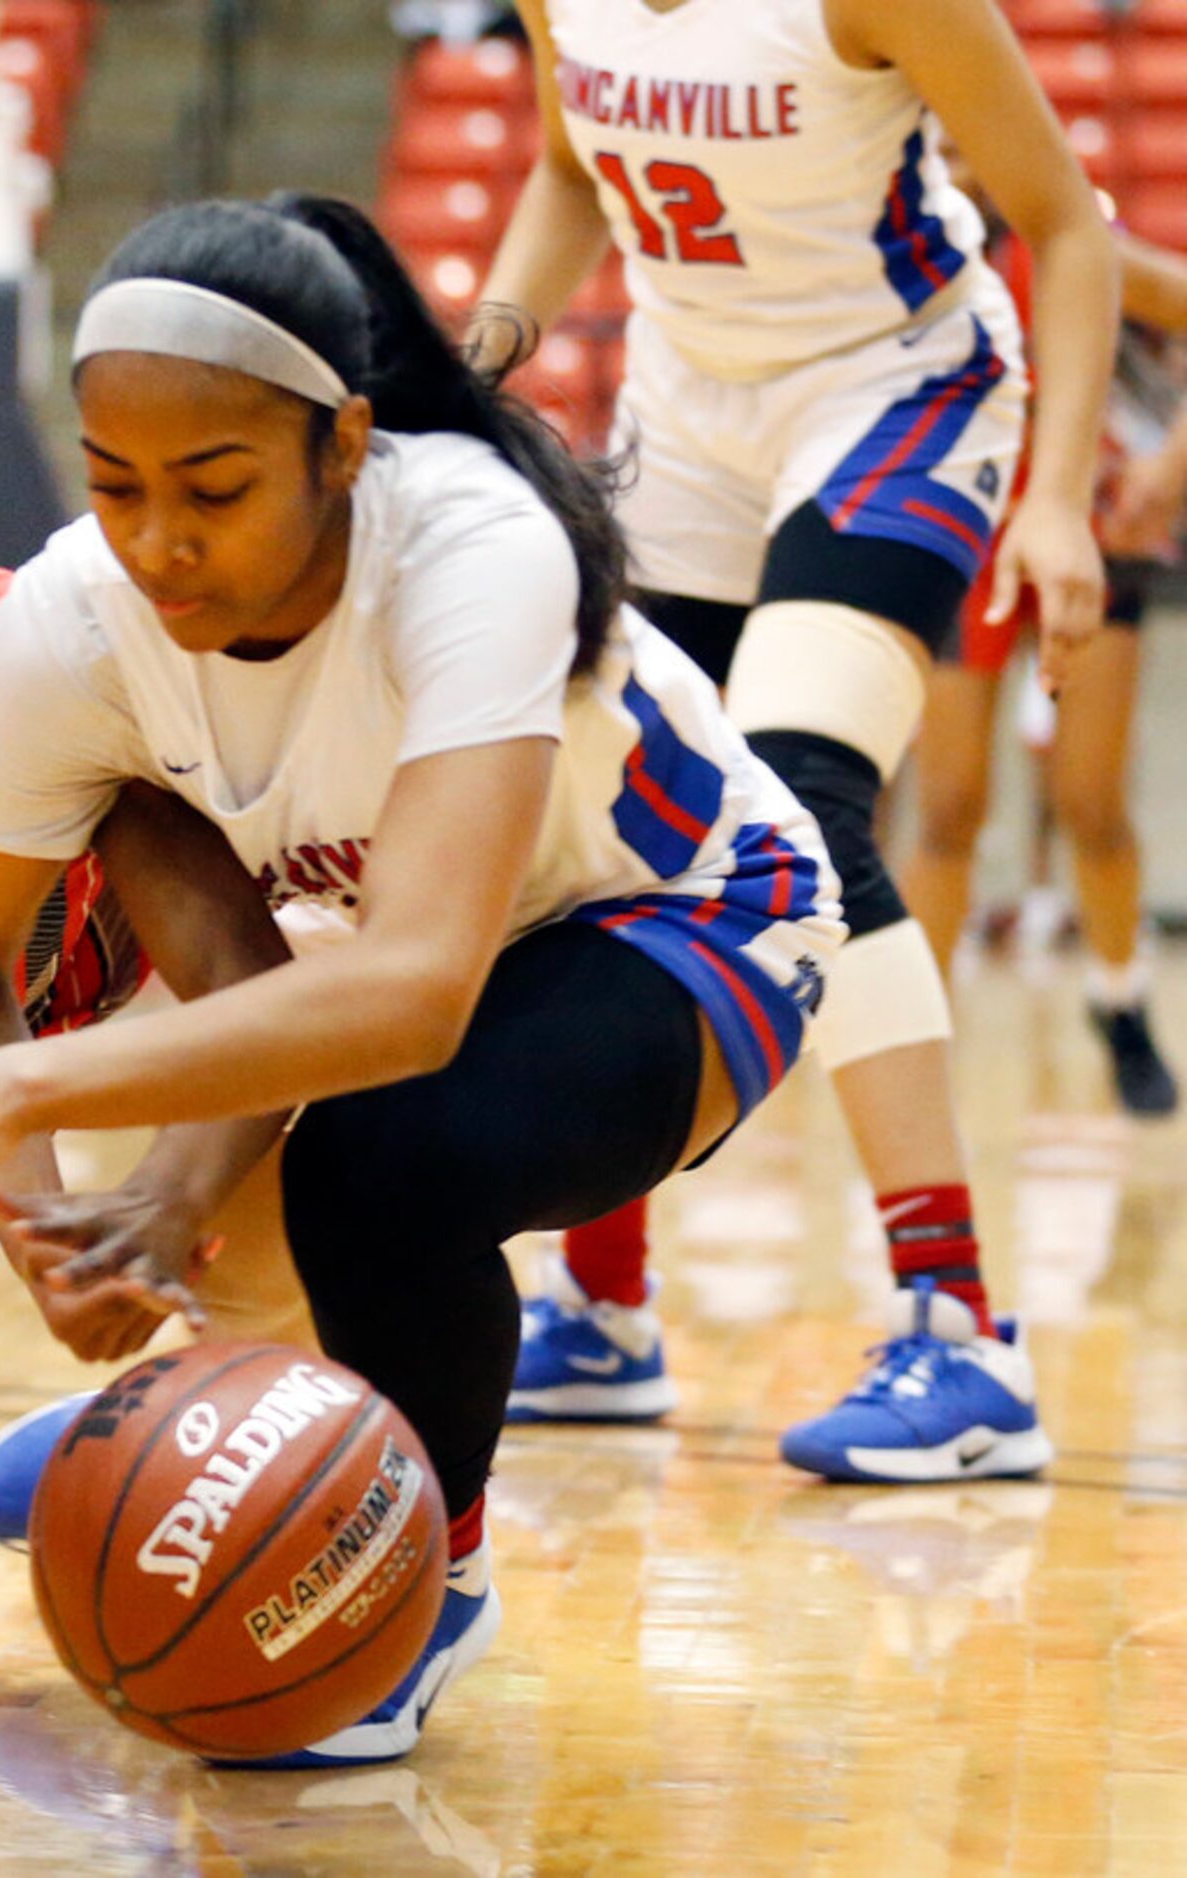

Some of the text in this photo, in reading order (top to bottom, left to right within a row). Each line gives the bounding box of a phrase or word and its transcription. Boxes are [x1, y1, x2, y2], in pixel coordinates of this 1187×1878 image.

[594, 151, 745, 267] 12
[137, 1363, 360, 1599] SPALDING
[245, 1480, 393, 1641] PLATINUM
